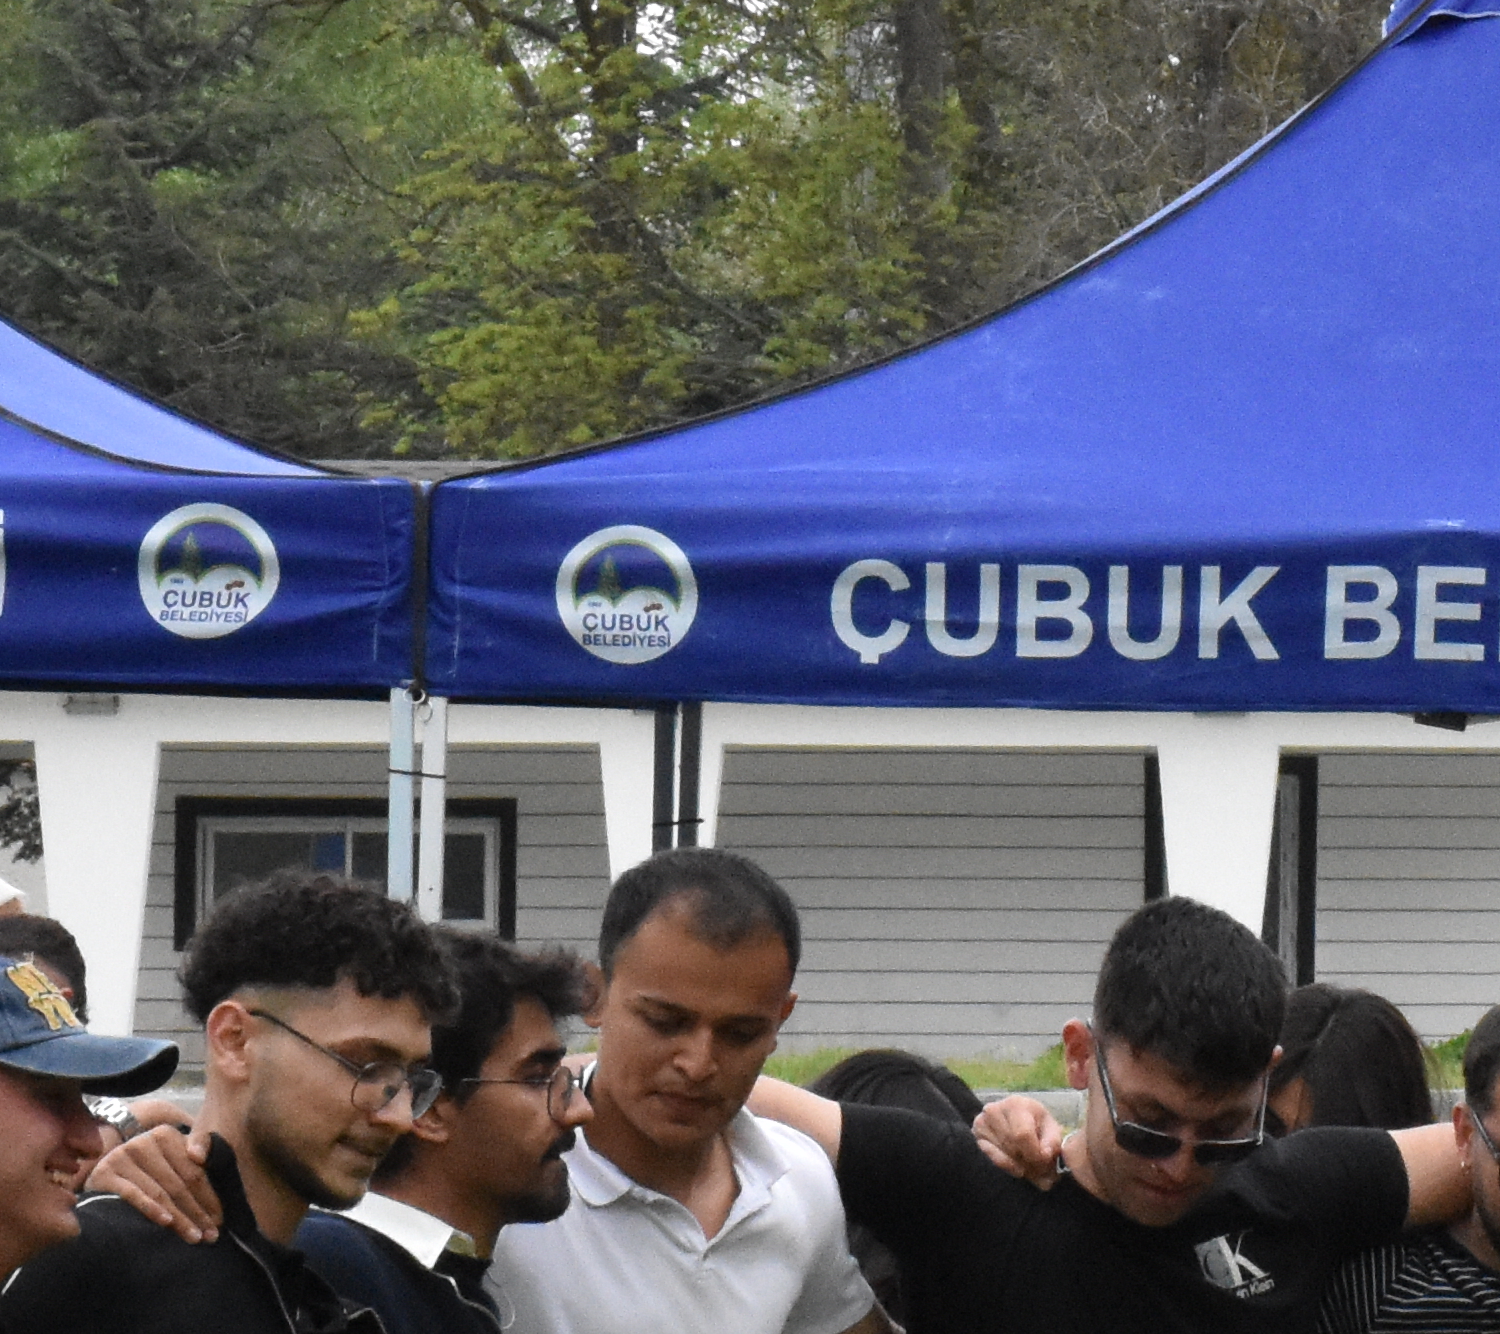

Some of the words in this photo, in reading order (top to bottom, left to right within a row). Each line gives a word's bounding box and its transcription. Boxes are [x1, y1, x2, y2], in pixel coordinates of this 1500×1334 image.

[162, 589, 251, 608] ÇUBUK
[159, 608, 249, 623] BELEDİYESİ
[830, 558, 1281, 665] ÇUBUK
[581, 612, 670, 632] ÇUBUK
[581, 632, 671, 648] BELEDİYESİ
